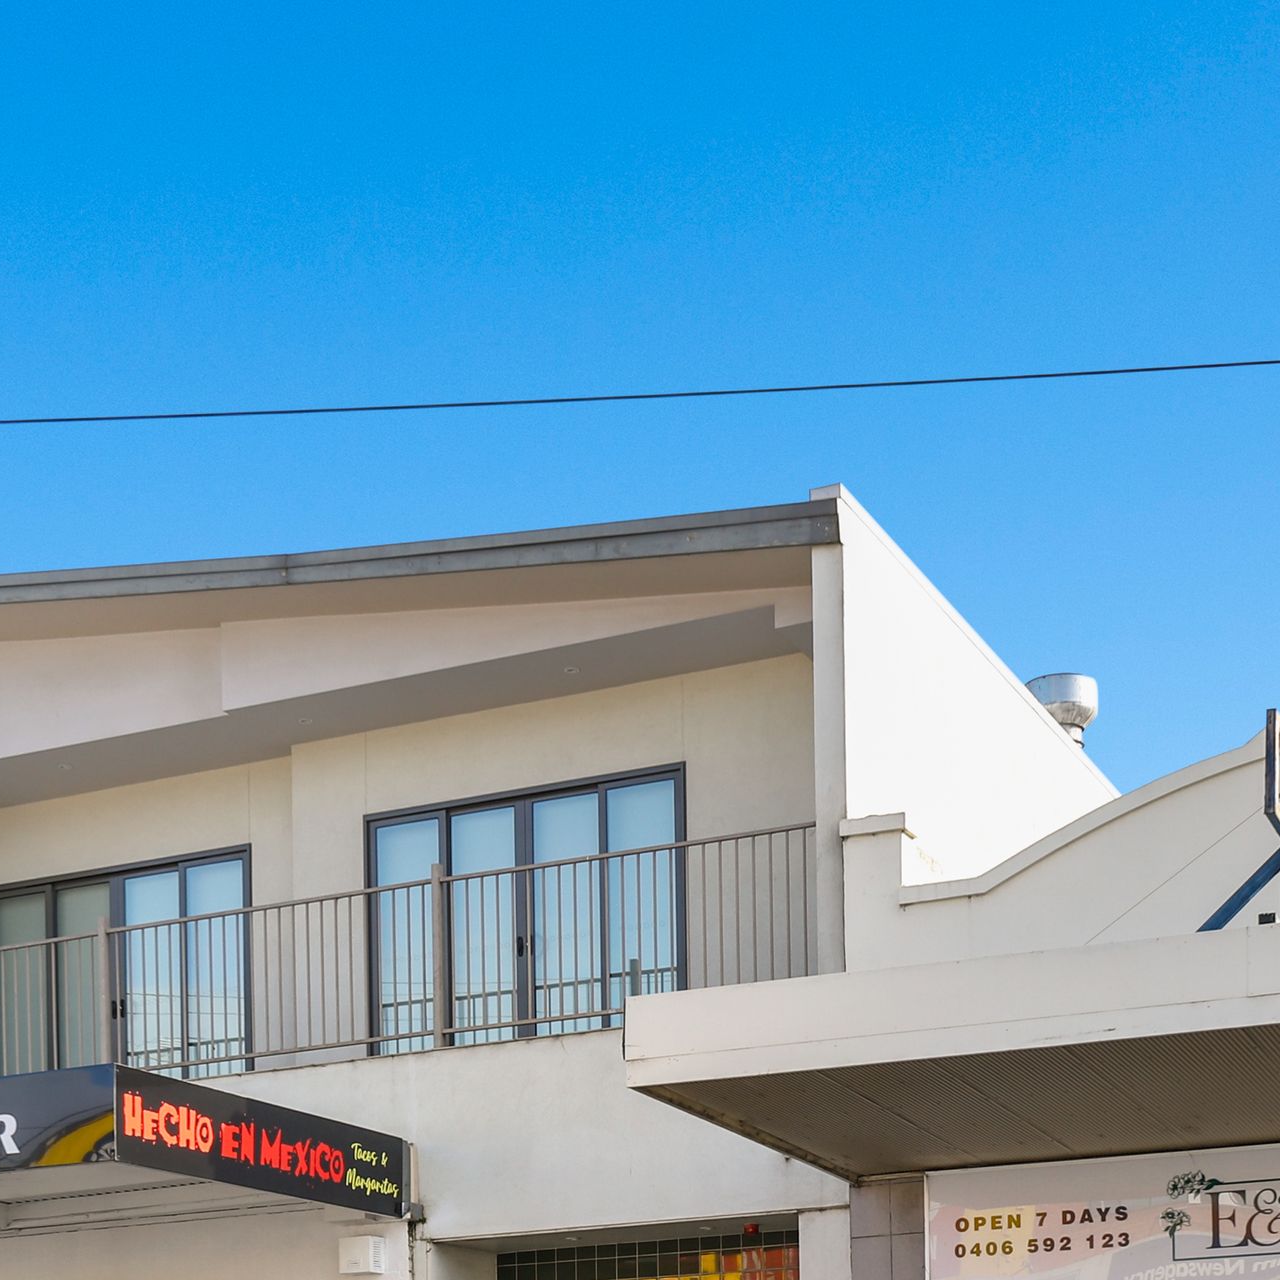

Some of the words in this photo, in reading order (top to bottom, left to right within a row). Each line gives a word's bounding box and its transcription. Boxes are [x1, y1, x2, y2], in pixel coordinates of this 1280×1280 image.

[122, 1092, 214, 1153] HECHO
[220, 1121, 255, 1166] EN
[259, 1128, 345, 1184] MEXICO
[351, 1142, 378, 1166] Tacos
[346, 1167, 399, 1198] Margaritas
[955, 1213, 1021, 1232] OPEN
[1036, 1212, 1047, 1227] 7
[1061, 1206, 1129, 1226] DAYS
[954, 1240, 1014, 1258] 0406
[1027, 1236, 1072, 1254] 592
[1086, 1232, 1130, 1249] 123
